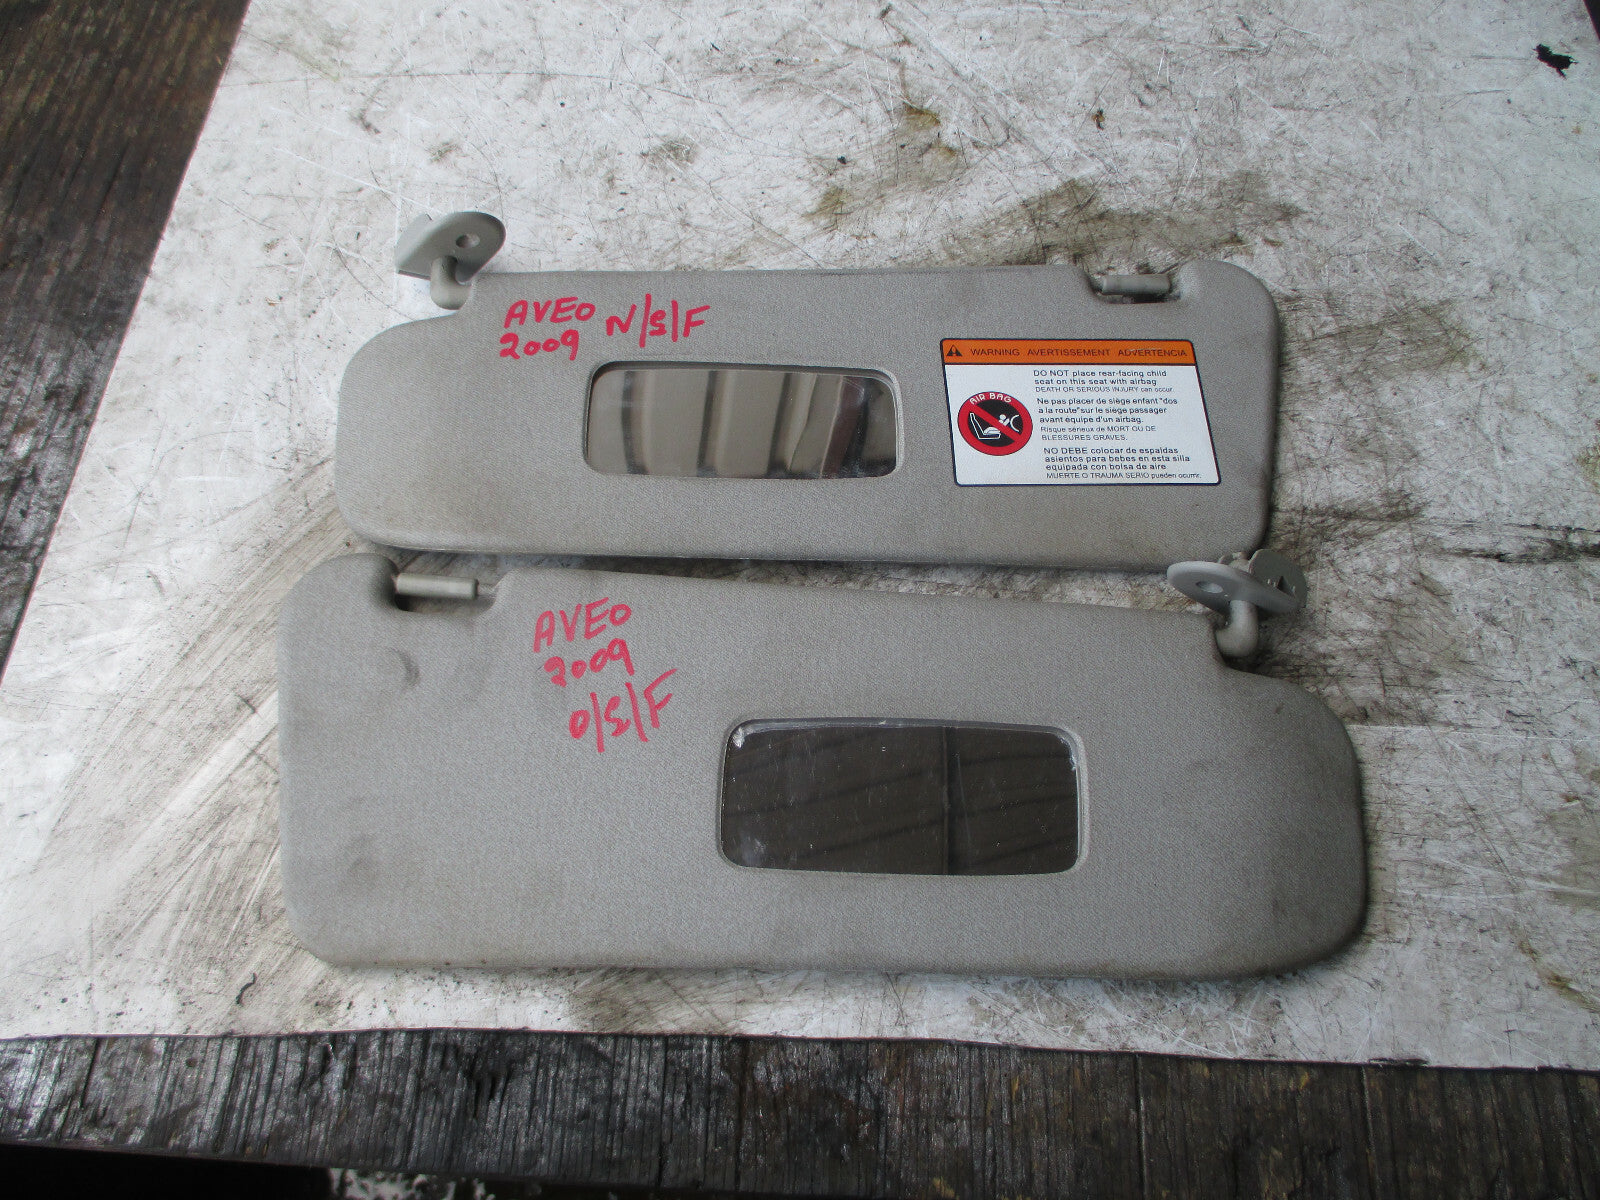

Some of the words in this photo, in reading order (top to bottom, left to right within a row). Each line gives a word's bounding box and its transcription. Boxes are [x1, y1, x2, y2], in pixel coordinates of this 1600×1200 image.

[504, 297, 596, 328] AVEO
[499, 329, 579, 361] 2009
[1118, 349, 1187, 357] ADVERTENCIA
[970, 394, 985, 405] AIR
[989, 393, 1011, 403] BAG
[1115, 416, 1143, 424] airbag.
[1139, 447, 1178, 455] espaldas
[533, 597, 632, 652] AVEO
[544, 638, 635, 688] 2009
